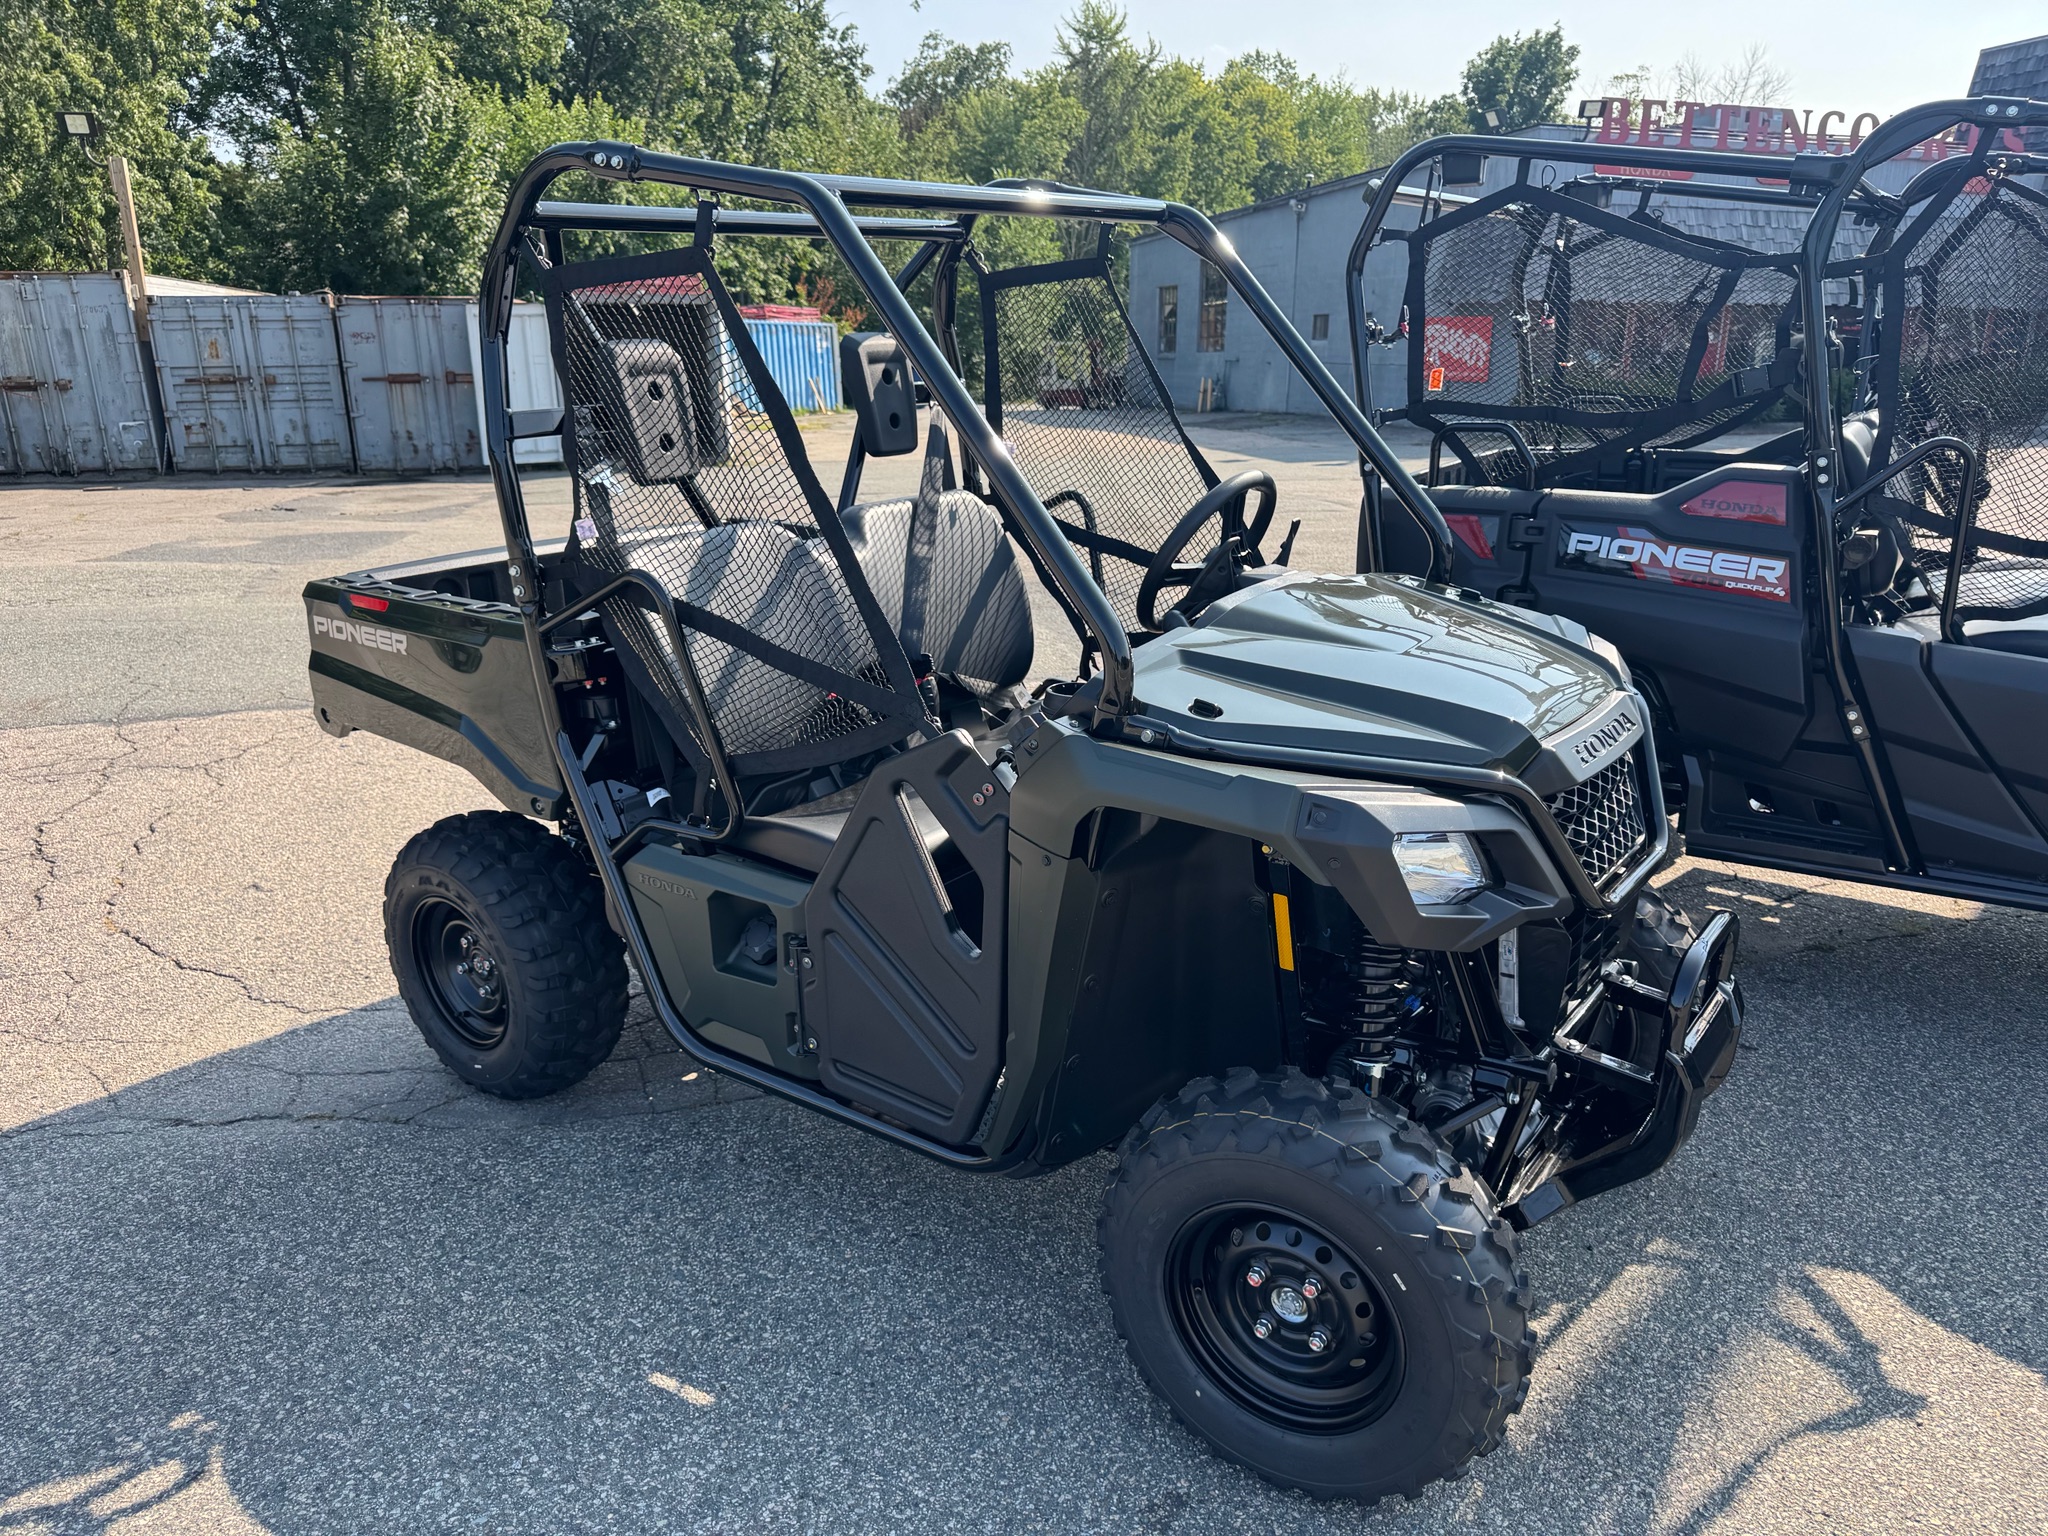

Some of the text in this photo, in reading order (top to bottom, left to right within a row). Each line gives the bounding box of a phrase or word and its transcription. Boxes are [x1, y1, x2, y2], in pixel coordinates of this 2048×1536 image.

[1700, 499, 1779, 517] HONDA
[1567, 532, 1786, 584] PIONEER
[312, 615, 408, 656] PIONEER
[1570, 712, 1638, 769] HONDA
[639, 872, 698, 900] HONDA
